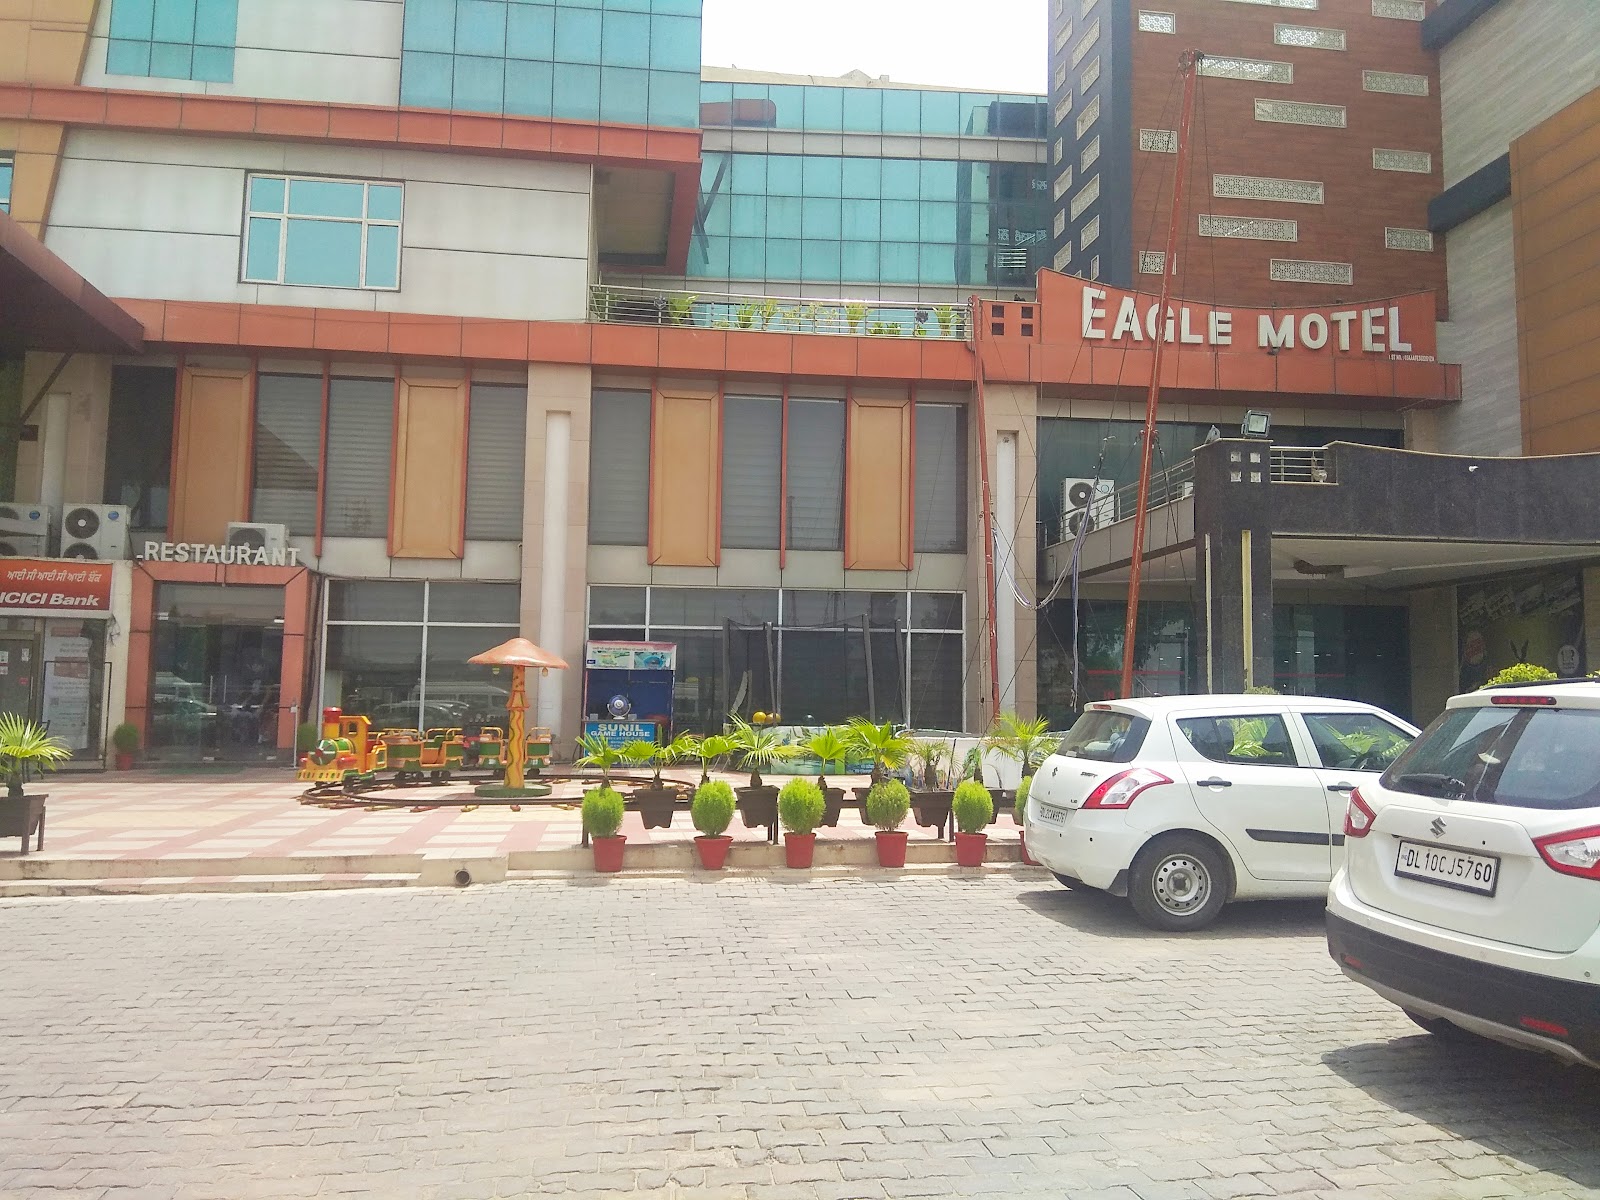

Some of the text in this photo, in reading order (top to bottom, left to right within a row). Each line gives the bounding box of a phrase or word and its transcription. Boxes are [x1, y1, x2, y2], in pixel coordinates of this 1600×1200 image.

[1082, 286, 1412, 352] EAGLE MOTEL
[144, 541, 301, 567] RESTAURANT
[0, 591, 100, 606] ICICI Bank
[597, 723, 644, 732] SUNIL
